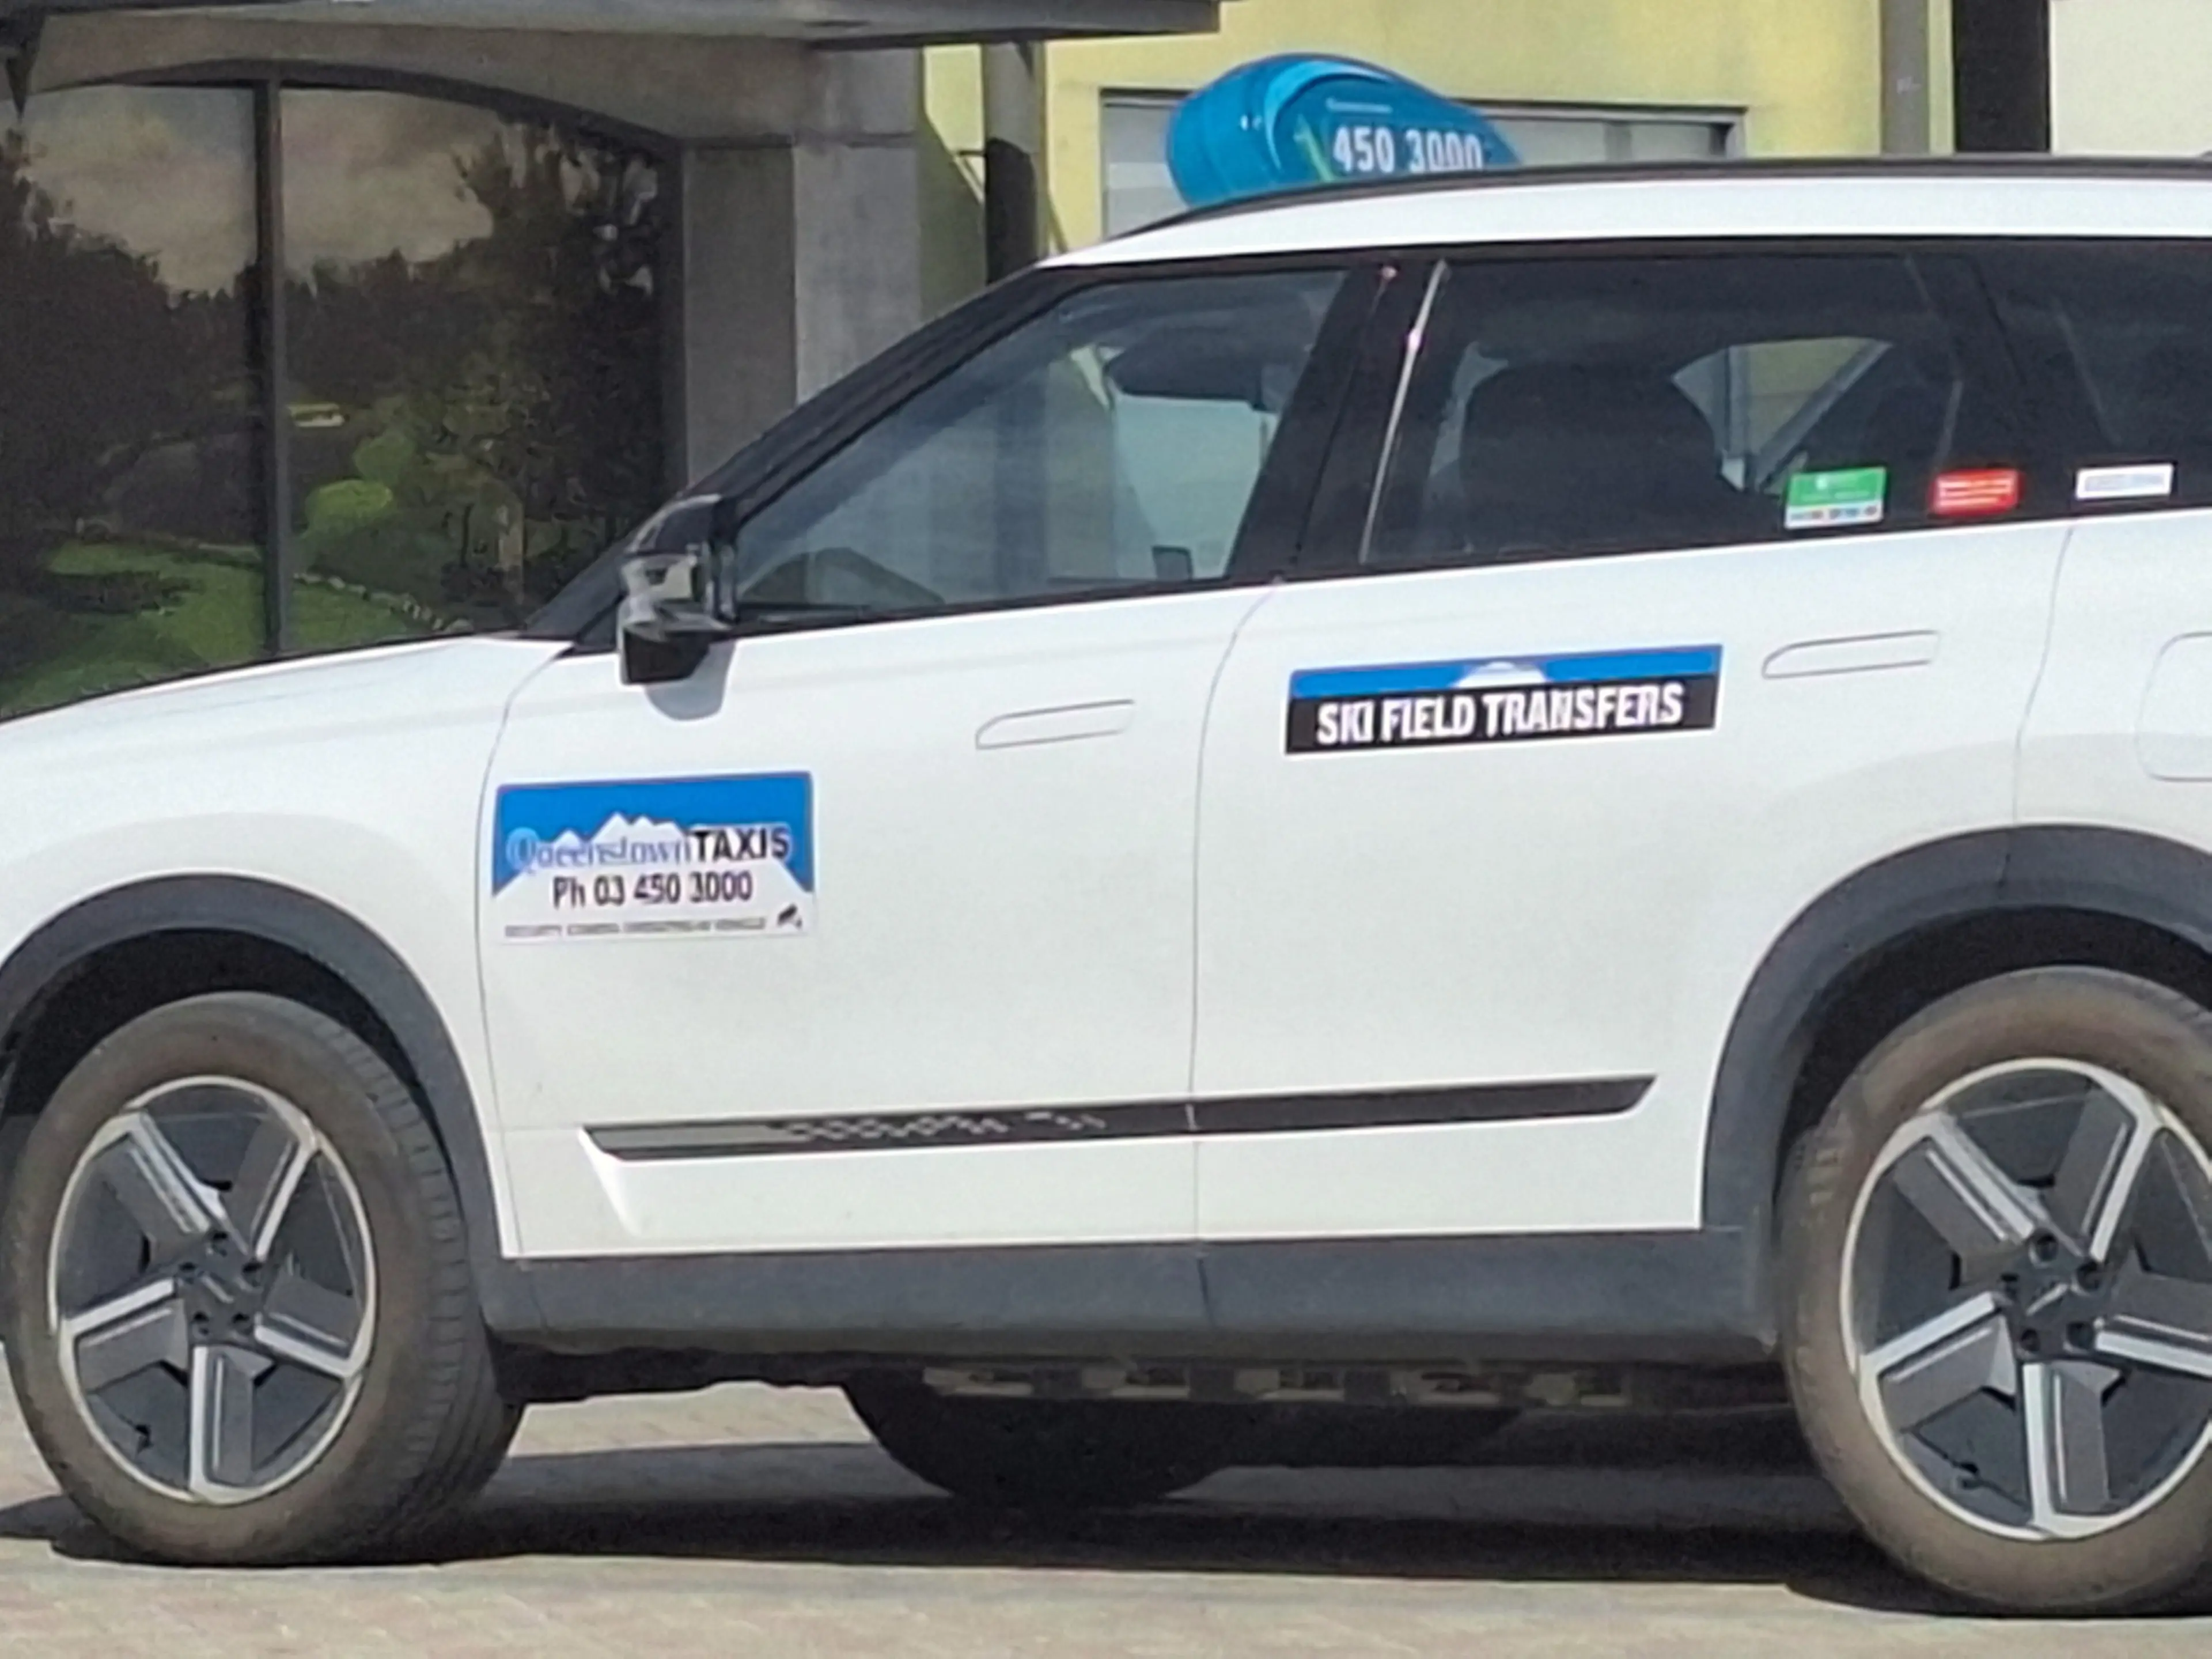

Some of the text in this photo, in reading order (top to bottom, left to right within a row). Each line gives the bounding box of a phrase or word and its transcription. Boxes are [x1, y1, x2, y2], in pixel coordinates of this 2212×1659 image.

[1332, 126, 1484, 172] 450 3000
[1316, 683, 1684, 745] SKI FIELD TRANSFERS
[553, 870, 753, 909] Ph 03 450 3000
